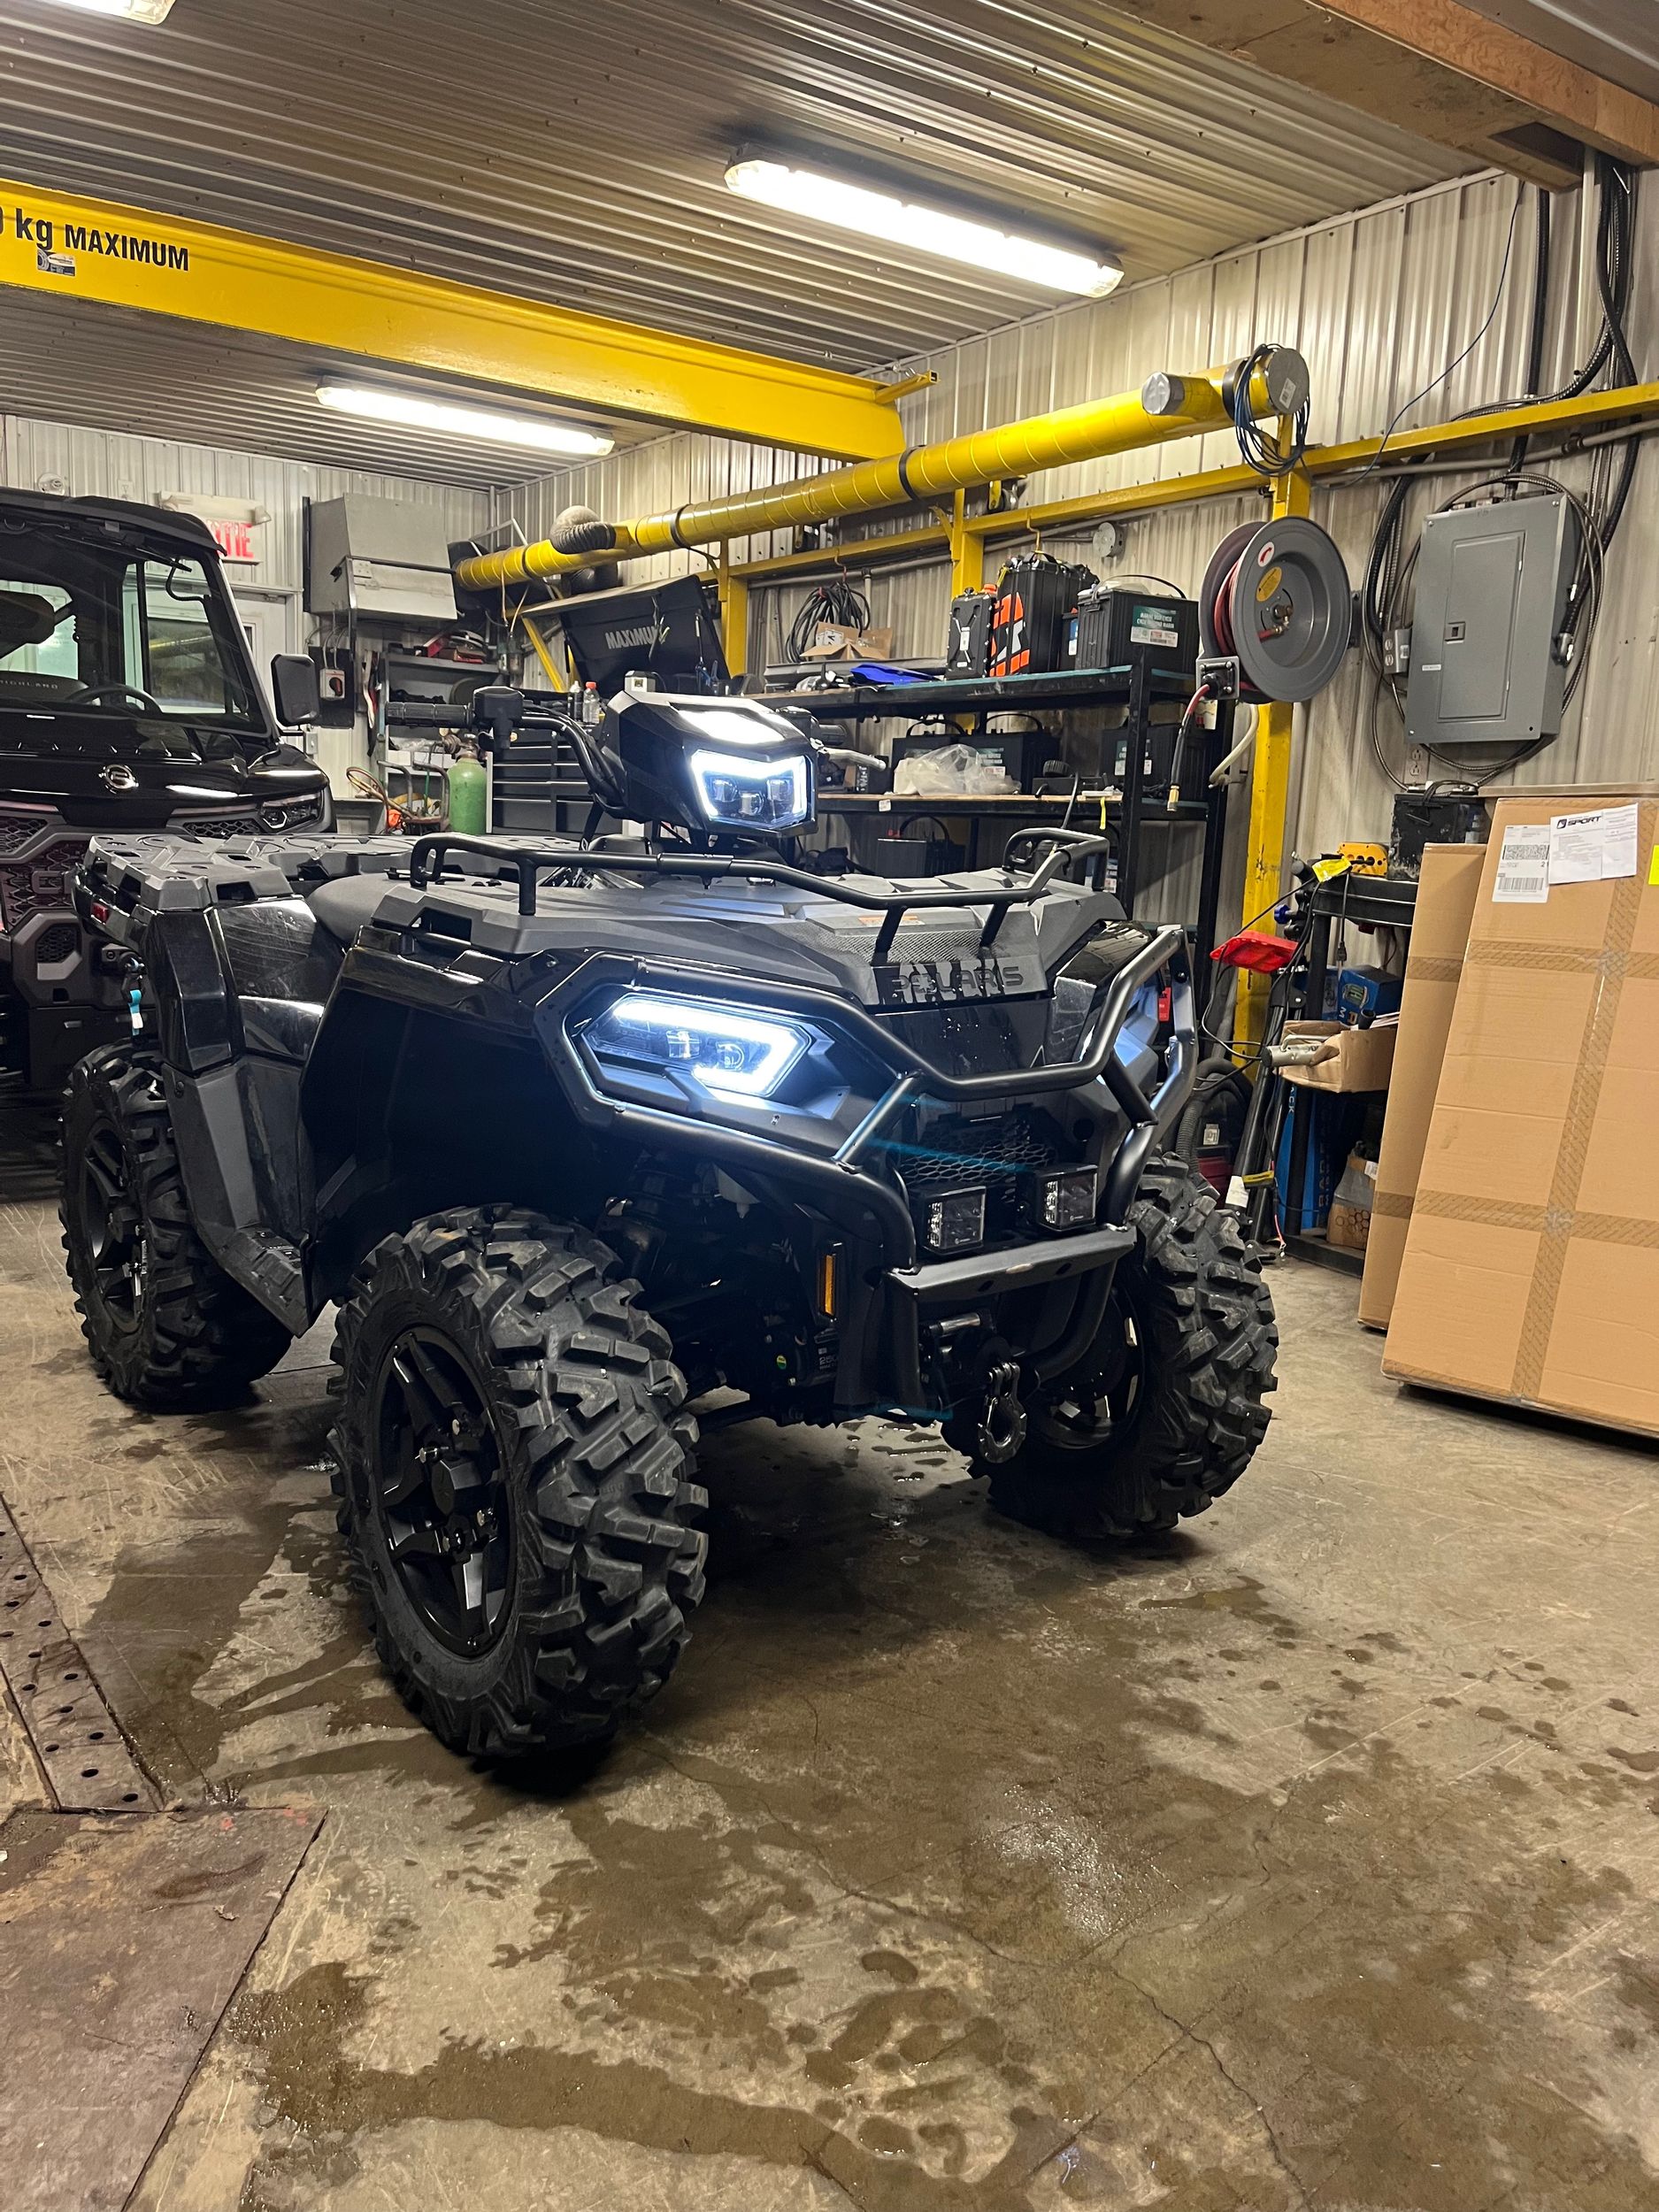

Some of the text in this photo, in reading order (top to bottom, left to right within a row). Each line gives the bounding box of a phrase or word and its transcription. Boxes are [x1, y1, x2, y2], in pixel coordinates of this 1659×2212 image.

[16, 208, 53, 250] kg
[65, 224, 189, 271] MAXIMUM
[605, 626, 664, 649] MAXIMU
[1567, 816, 1602, 826] SPORT
[892, 966, 1025, 994] POLARIS
